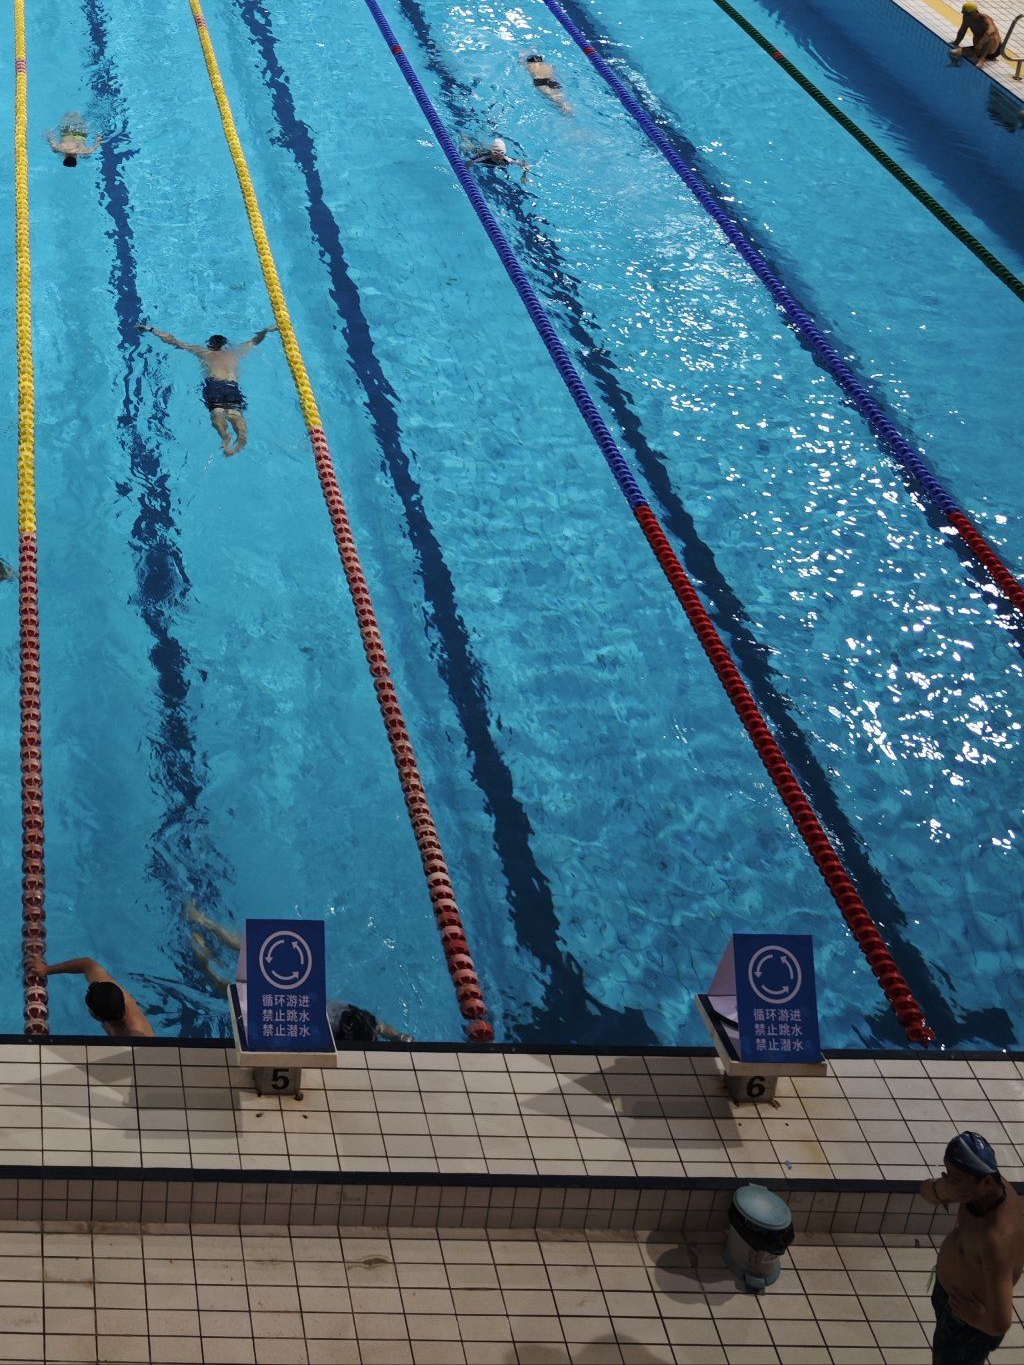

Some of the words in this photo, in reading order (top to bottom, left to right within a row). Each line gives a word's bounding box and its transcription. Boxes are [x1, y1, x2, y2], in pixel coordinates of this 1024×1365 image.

[262, 994, 310, 1007] 循环游进
[262, 1009, 311, 1022] 禁止跳水
[753, 1008, 803, 1022] 循环游进
[262, 1024, 311, 1037] 禁止潜水
[754, 1023, 804, 1036] 禁止跳水
[756, 1038, 805, 1051] 禁止潜水
[272, 1068, 289, 1090] 5
[746, 1076, 766, 1098] 6
